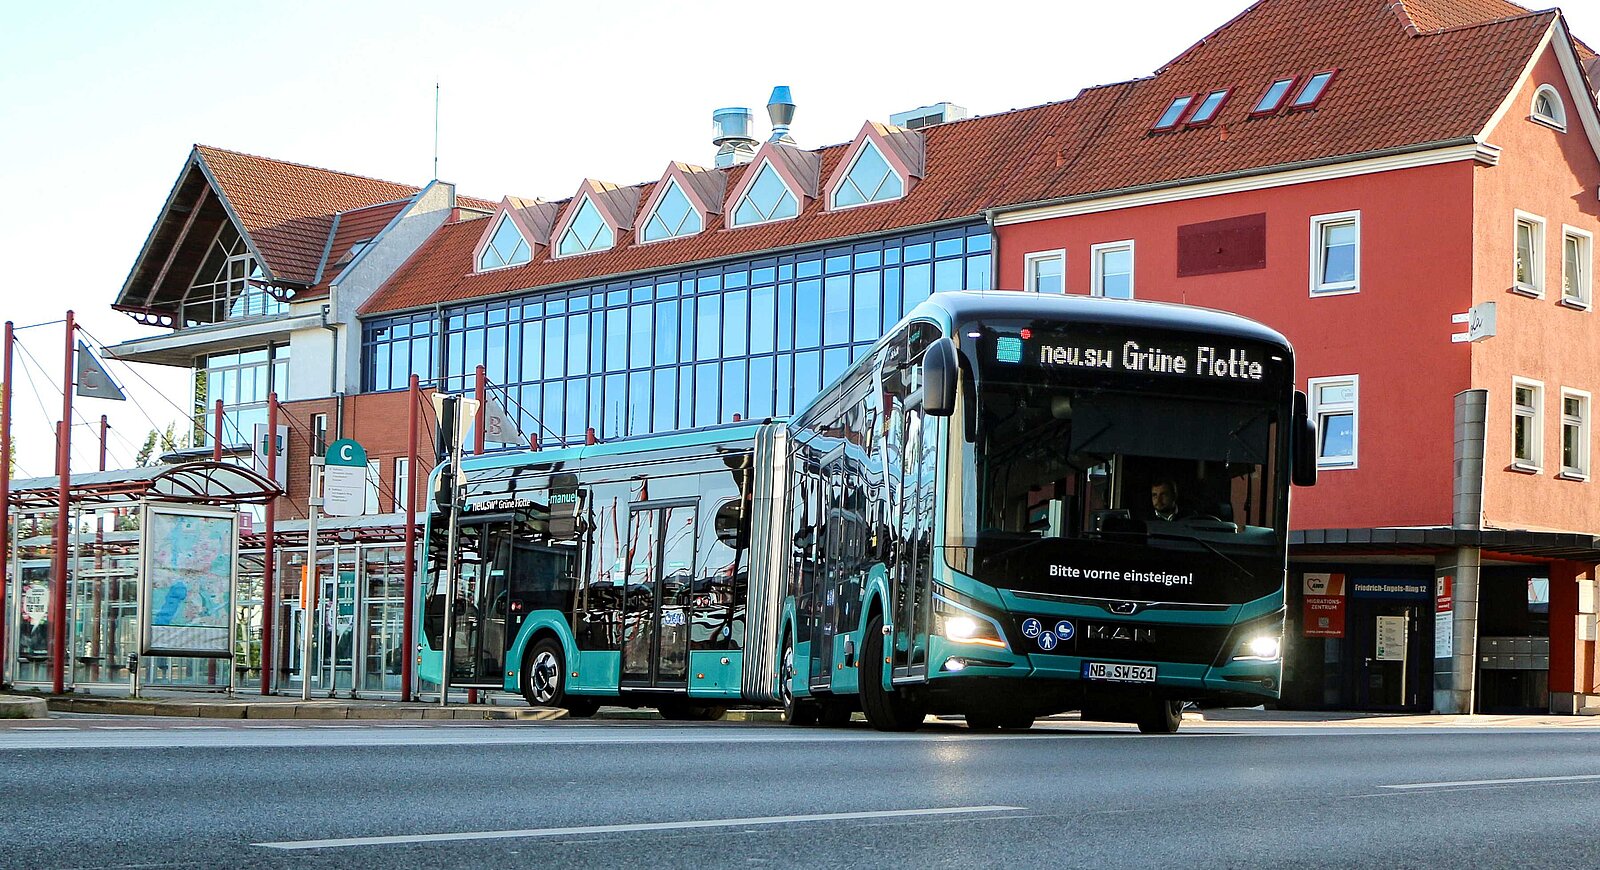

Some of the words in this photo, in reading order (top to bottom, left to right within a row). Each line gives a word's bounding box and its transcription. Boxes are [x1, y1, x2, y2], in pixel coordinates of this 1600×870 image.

[1040, 344, 1112, 368] neu.sw
[1122, 340, 1187, 374] Grüne
[1196, 346, 1263, 380] Flotte
[81, 367, 98, 389] C
[489, 416, 502, 435] B
[340, 444, 353, 461] C
[1049, 564, 1080, 578] Bitte
[1083, 569, 1120, 581] vorne
[1123, 570, 1193, 586] einsteigen!
[1420, 585, 1427, 593] 12
[1087, 625, 1156, 643] MAN
[1090, 664, 1106, 677] NB
